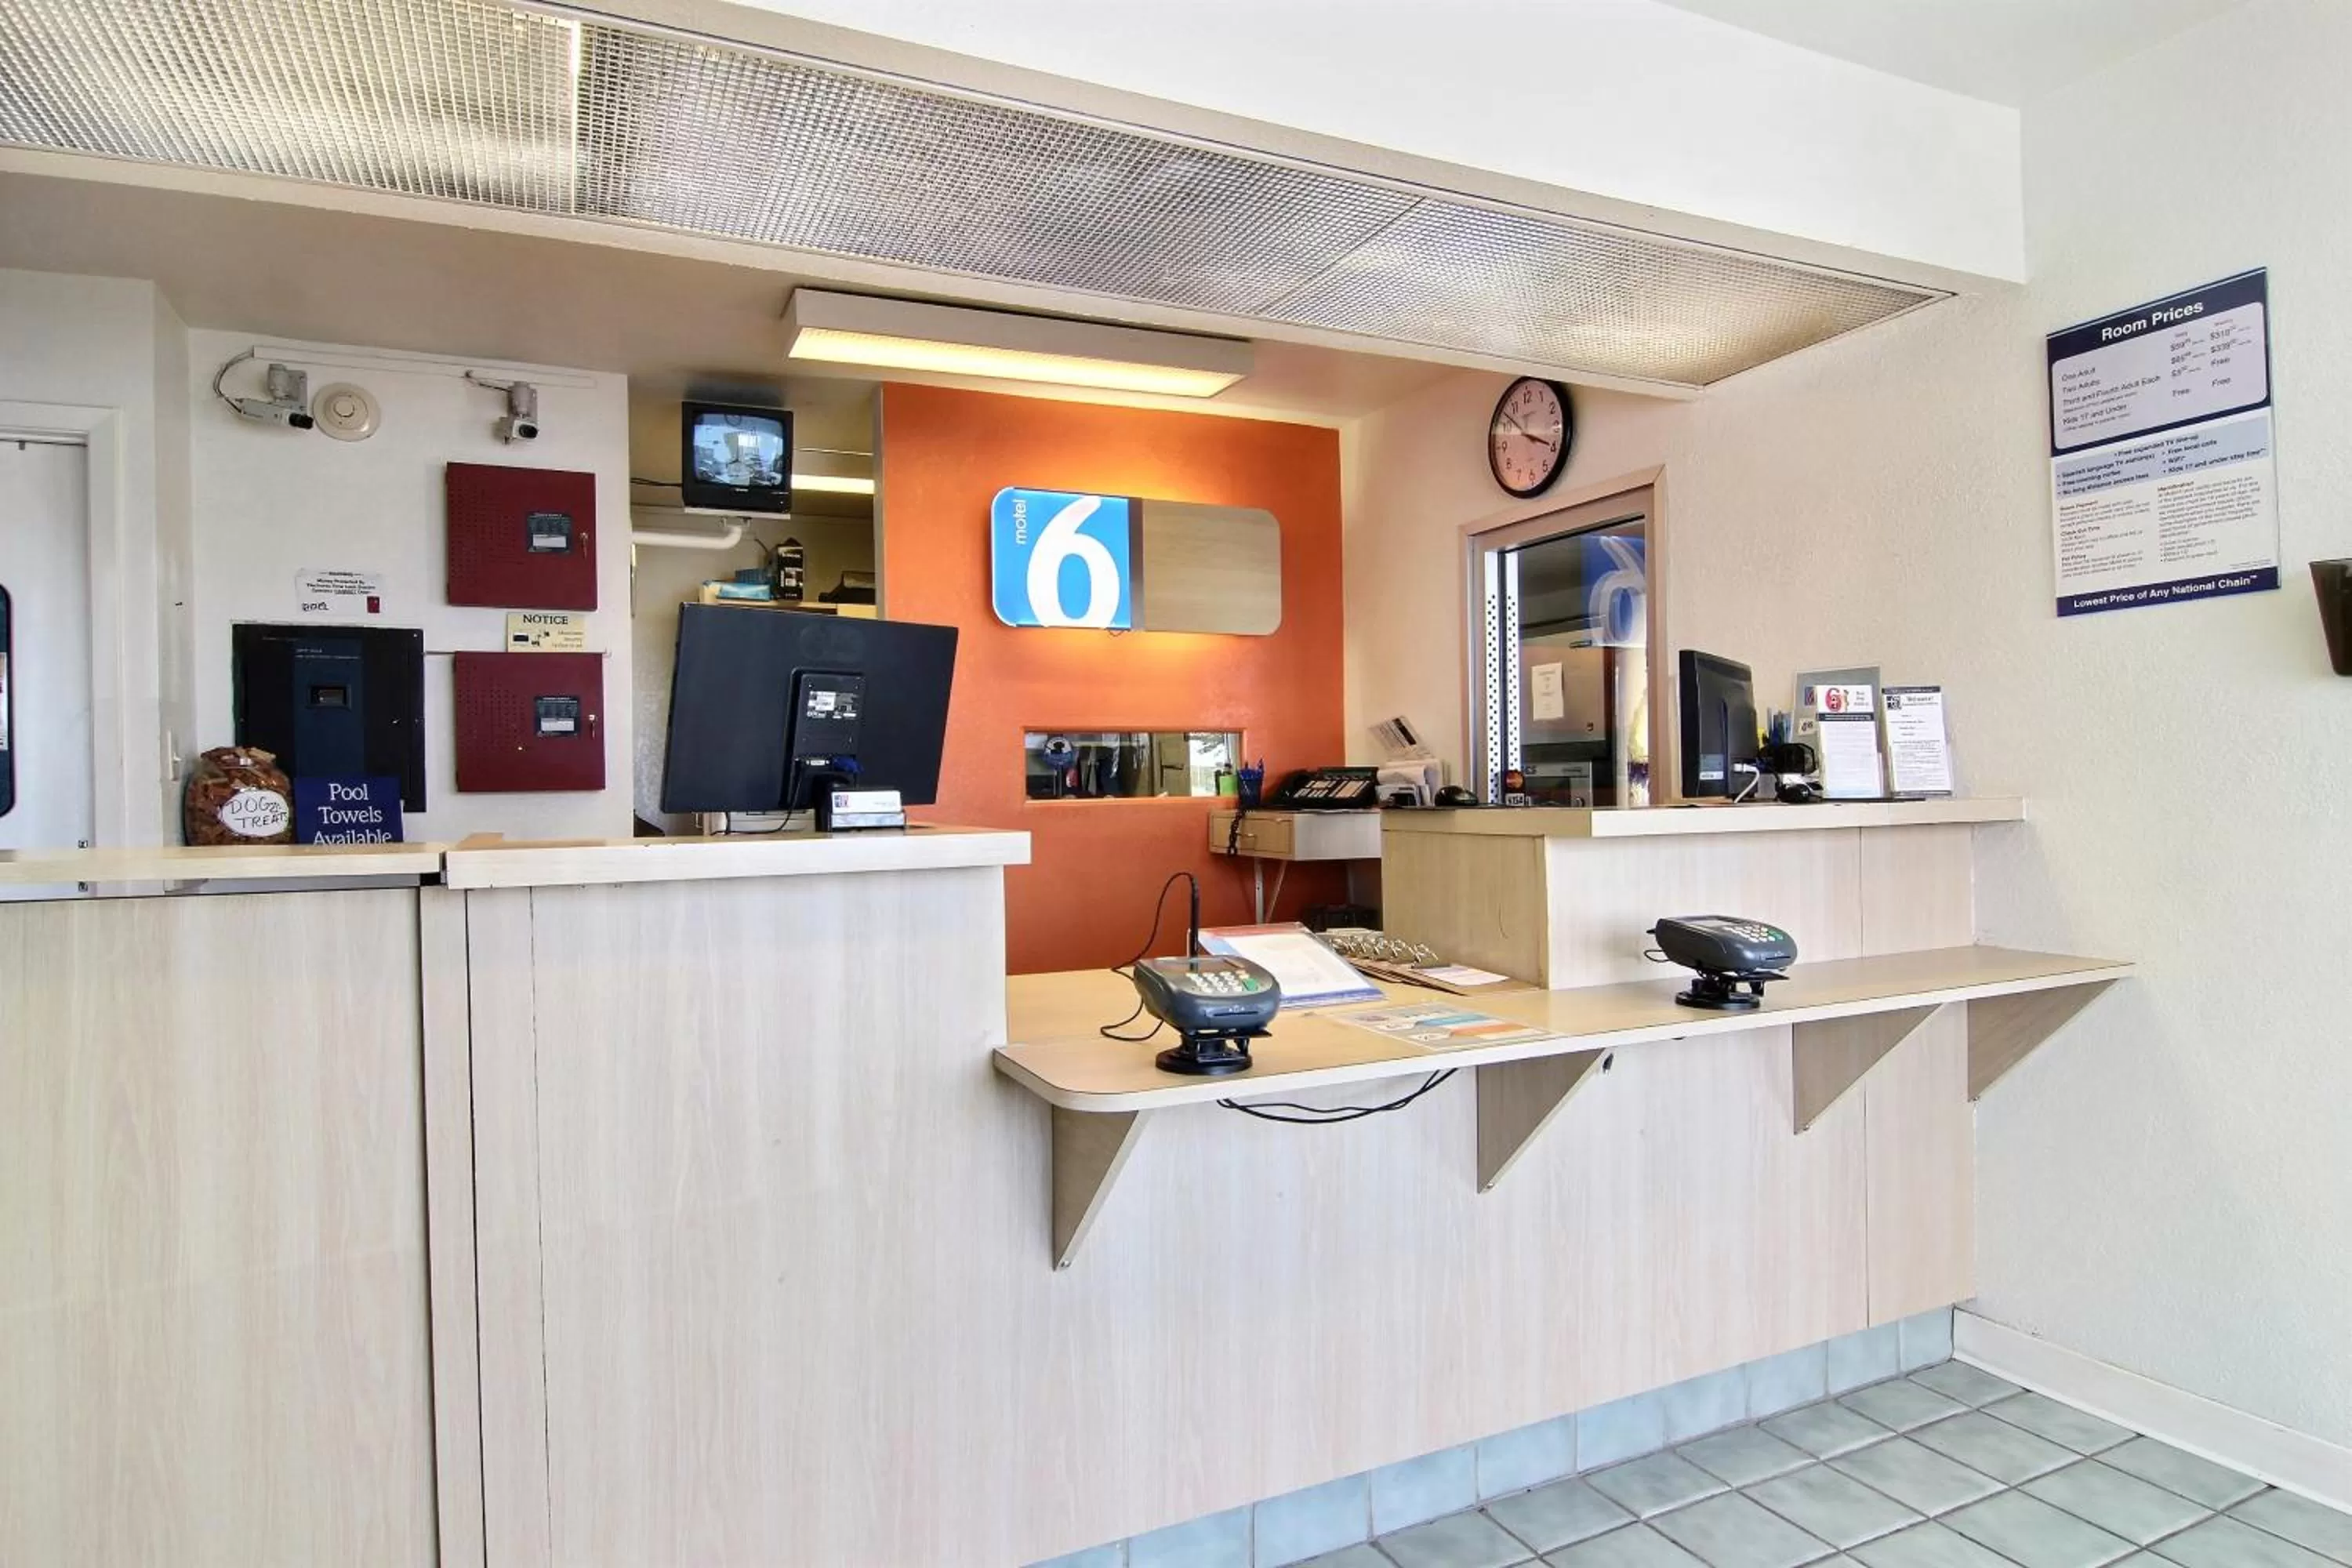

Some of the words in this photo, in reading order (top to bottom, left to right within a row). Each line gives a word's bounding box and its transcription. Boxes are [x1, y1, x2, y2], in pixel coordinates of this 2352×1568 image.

[2101, 319, 2147, 341] Room
[2151, 302, 2203, 326] Prices
[2210, 357, 2230, 367] Free
[2212, 377, 2231, 387] Free
[2183, 442, 2201, 452] local
[2194, 459, 2208, 468] and
[2209, 456, 2229, 466] under
[1014, 499, 1027, 546] motel
[1026, 495, 1120, 628] 6
[2074, 597, 2107, 608] Lowest
[2110, 591, 2135, 604] Price
[2136, 590, 2147, 599] of
[2149, 587, 2169, 599] Any
[2172, 581, 2216, 595] National
[522, 614, 568, 625] NOTICE
[329, 783, 369, 800] Pool
[318, 805, 383, 824] Towels
[314, 830, 391, 844] Available
